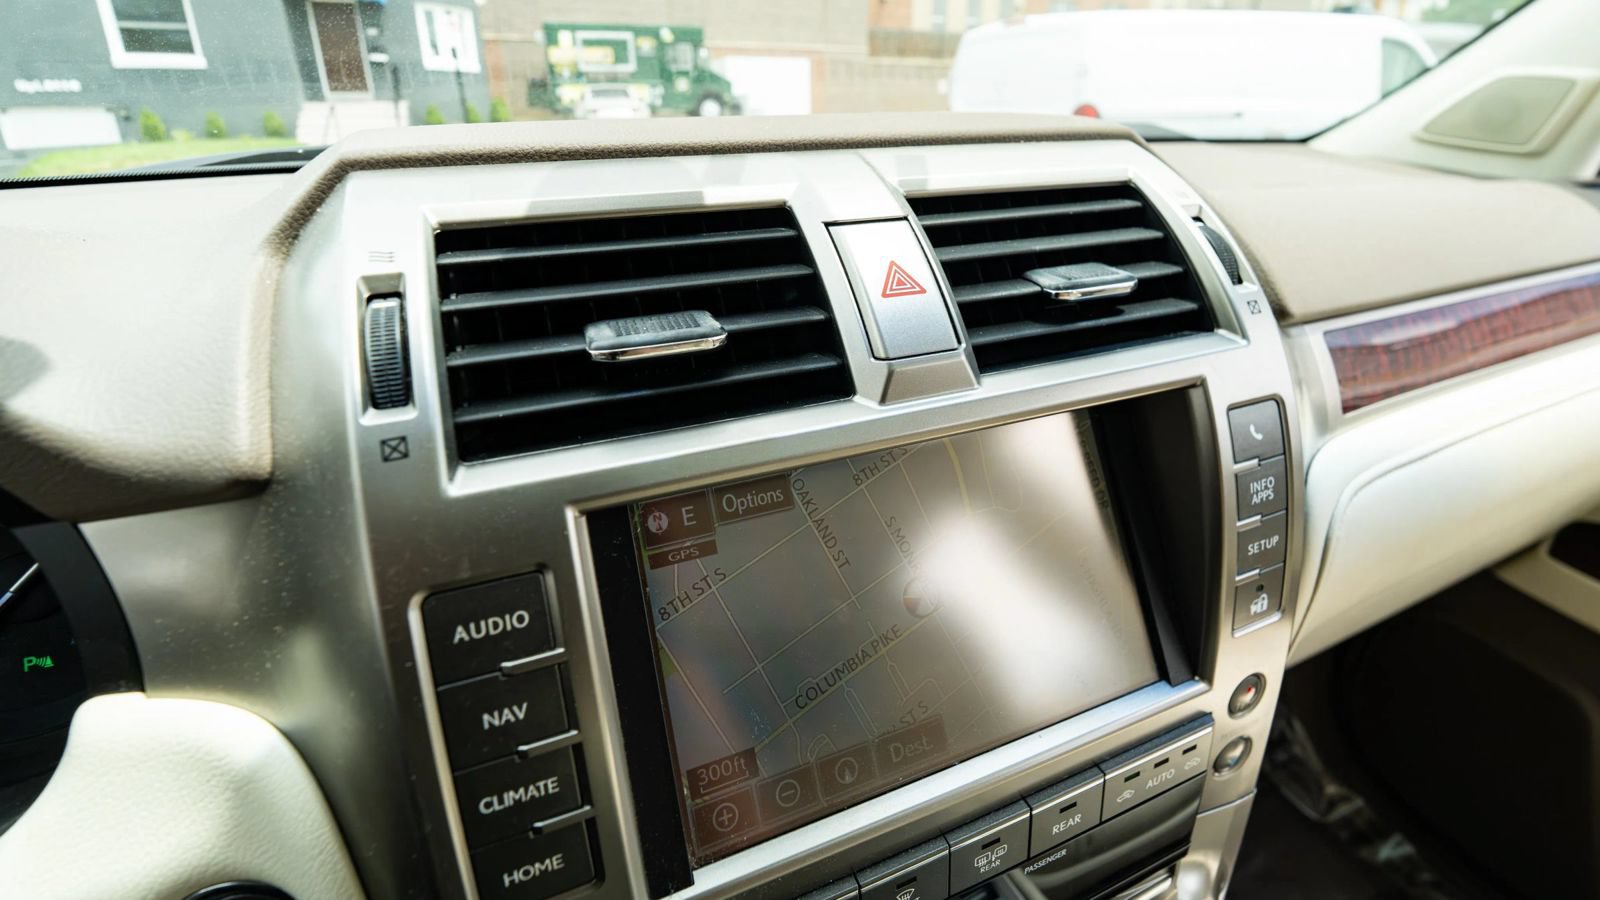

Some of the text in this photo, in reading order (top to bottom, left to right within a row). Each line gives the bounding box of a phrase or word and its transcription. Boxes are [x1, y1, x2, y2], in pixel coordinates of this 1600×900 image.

[851, 462, 880, 487] 8TH
[880, 450, 897, 467] ST
[1249, 476, 1275, 494] INFO
[1251, 488, 1275, 506] APPS
[722, 487, 785, 515] Options
[681, 505, 697, 527] E
[792, 478, 838, 550] OAKLAND
[832, 549, 852, 569] ST
[884, 515, 897, 529] S
[668, 546, 700, 562] GPS
[1247, 535, 1280, 556] SETUP
[658, 567, 727, 621] 8TH ST S
[453, 609, 531, 645] AUDIO
[795, 623, 903, 710] COLUMBIA PIKE
[481, 702, 529, 730] NAV
[696, 755, 748, 786] 300ft
[1145, 768, 1176, 790] AUTO
[478, 776, 561, 815] CLIMATE
[1051, 813, 1082, 836] REAR
[502, 853, 566, 888] HOME
[980, 859, 1001, 873] REAR
[1024, 848, 1068, 875] PASSENGER
